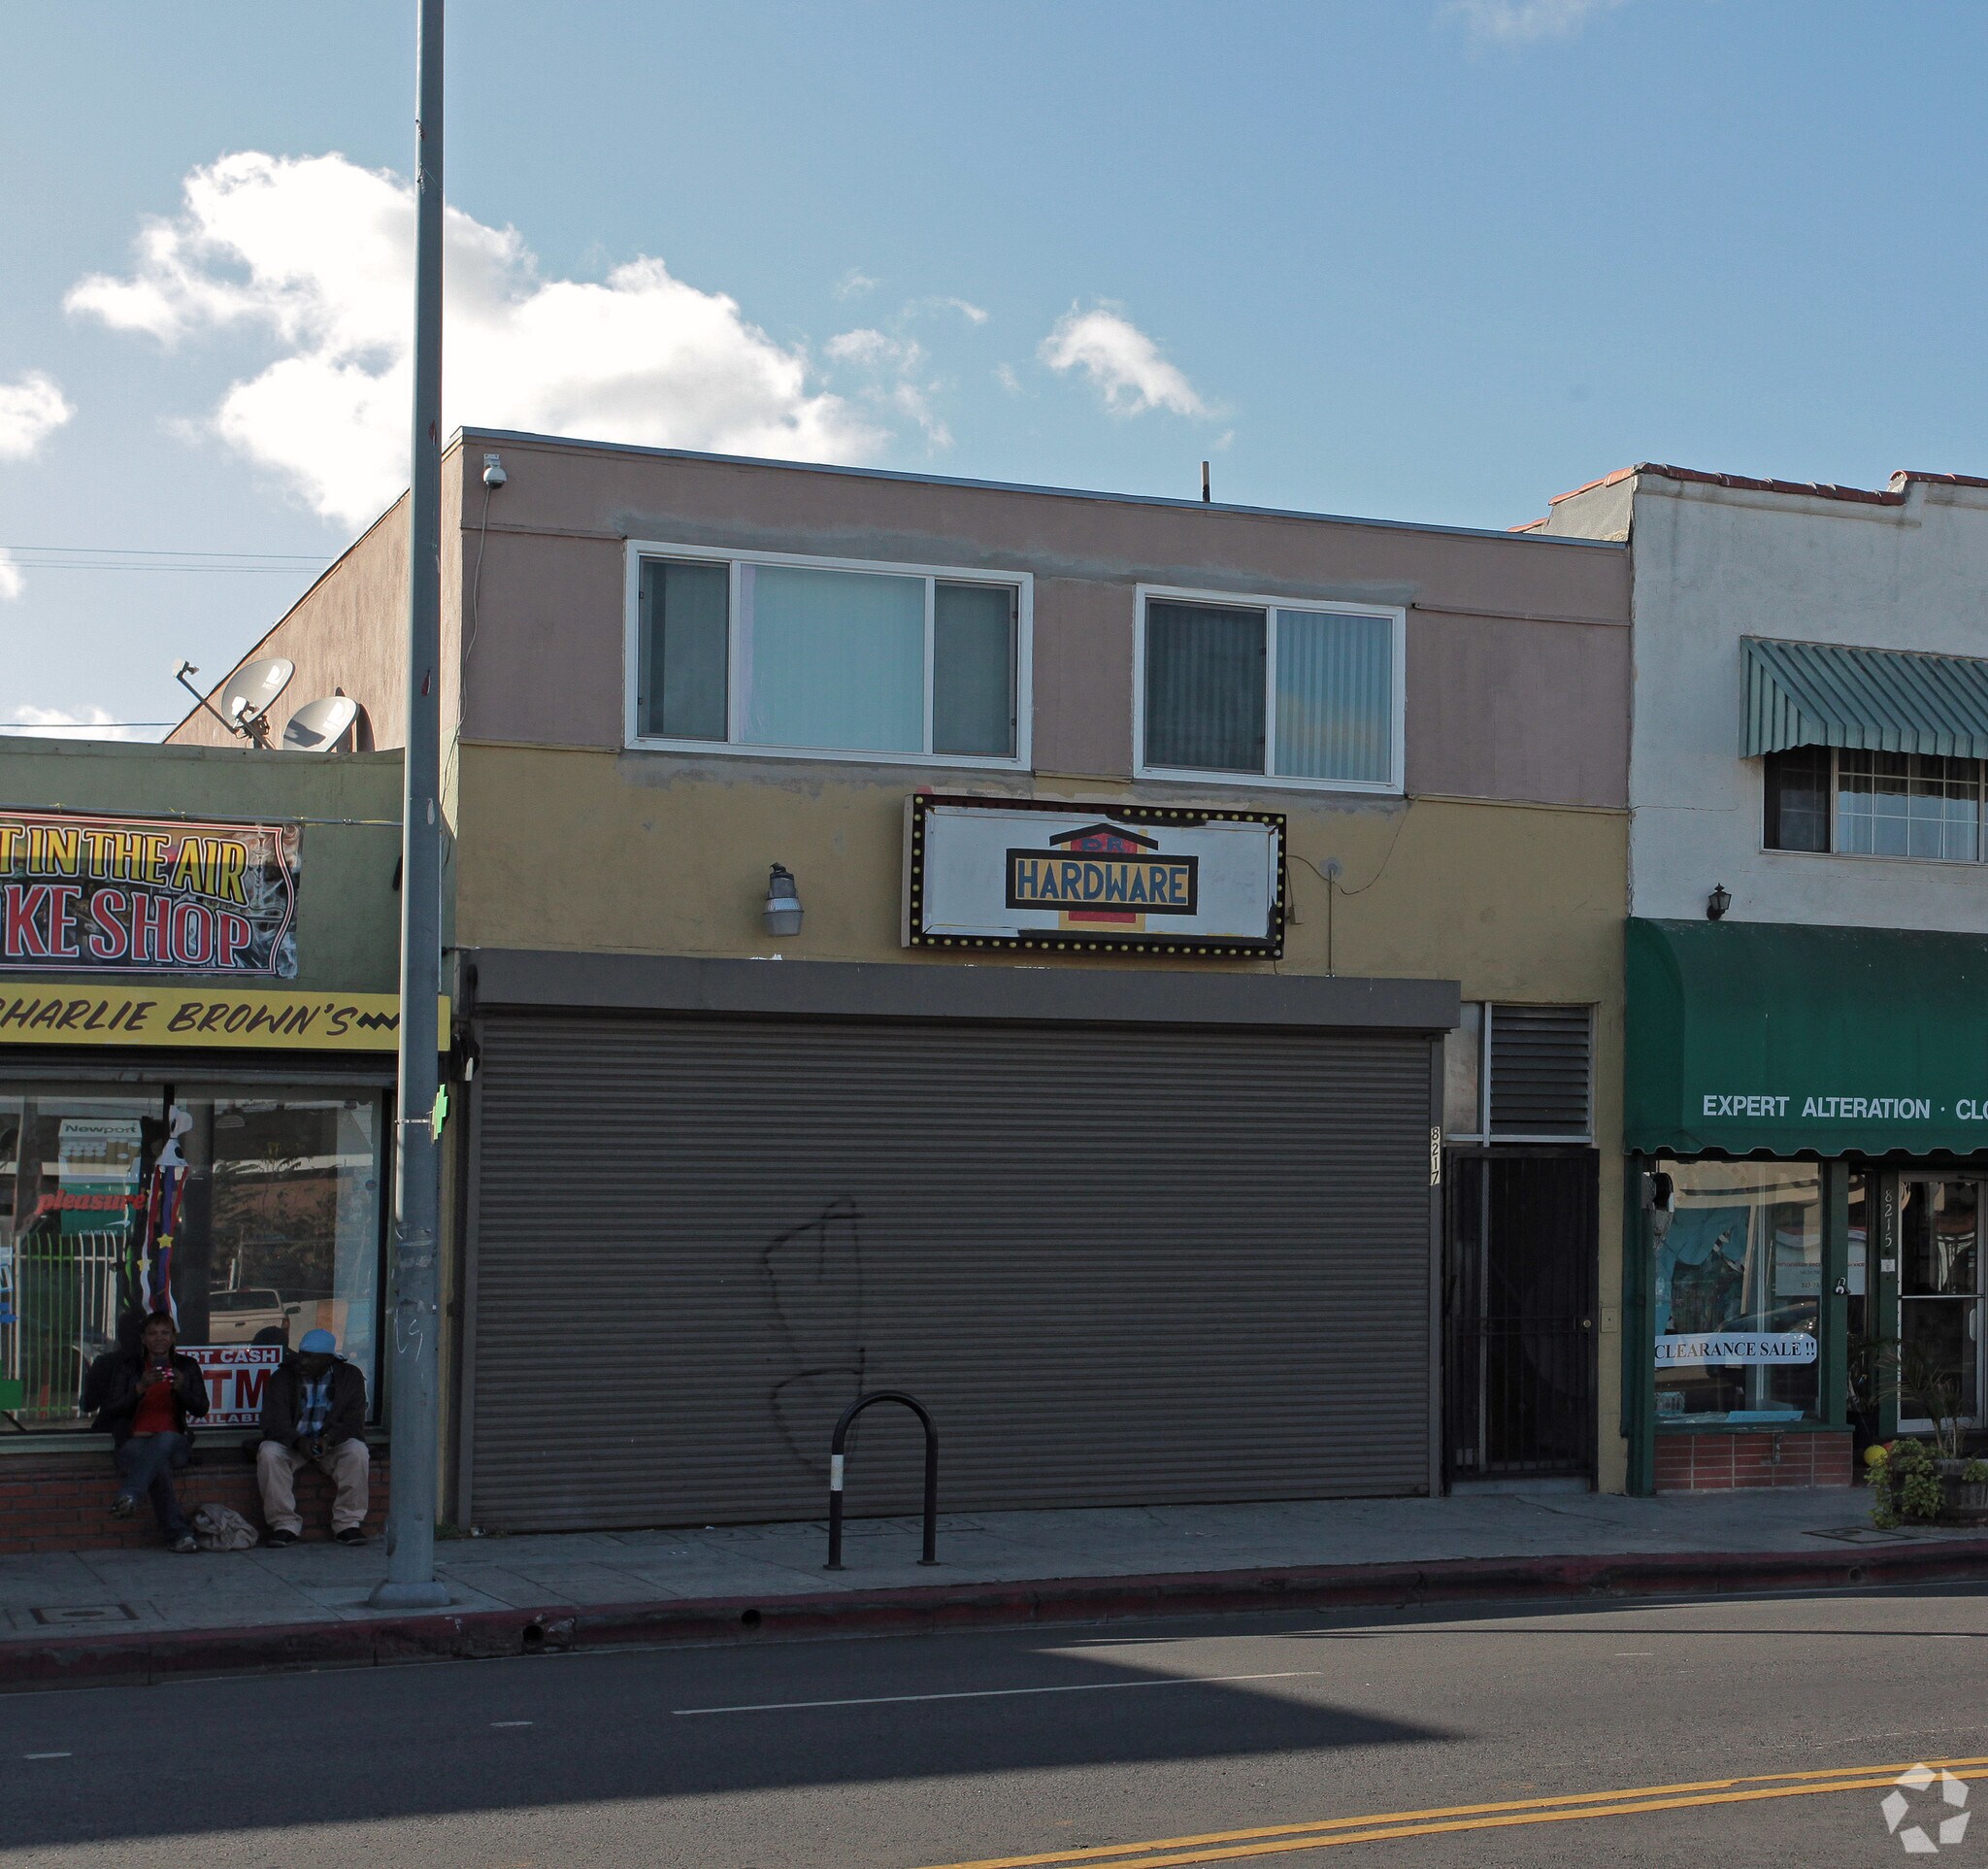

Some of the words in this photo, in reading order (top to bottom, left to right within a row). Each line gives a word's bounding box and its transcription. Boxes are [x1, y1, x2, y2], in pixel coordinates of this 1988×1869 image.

[28, 827, 80, 877] IN
[83, 830, 169, 886] THE
[171, 836, 249, 908] AIR
[1017, 860, 1187, 904] HARDWARE
[5, 884, 82, 957] KE
[89, 887, 251, 967] SHOP
[167, 1002, 358, 1037] BROWN'S
[1703, 1095, 1790, 1116] EXPERT
[1802, 1097, 1930, 1118] ALTERATION
[65, 1123, 137, 1133] Newport
[1884, 1188, 1893, 1248] 8215
[220, 1350, 276, 1363] CASH
[1655, 1342, 1755, 1359] CLEARANCE
[1760, 1342, 1802, 1356] SALE
